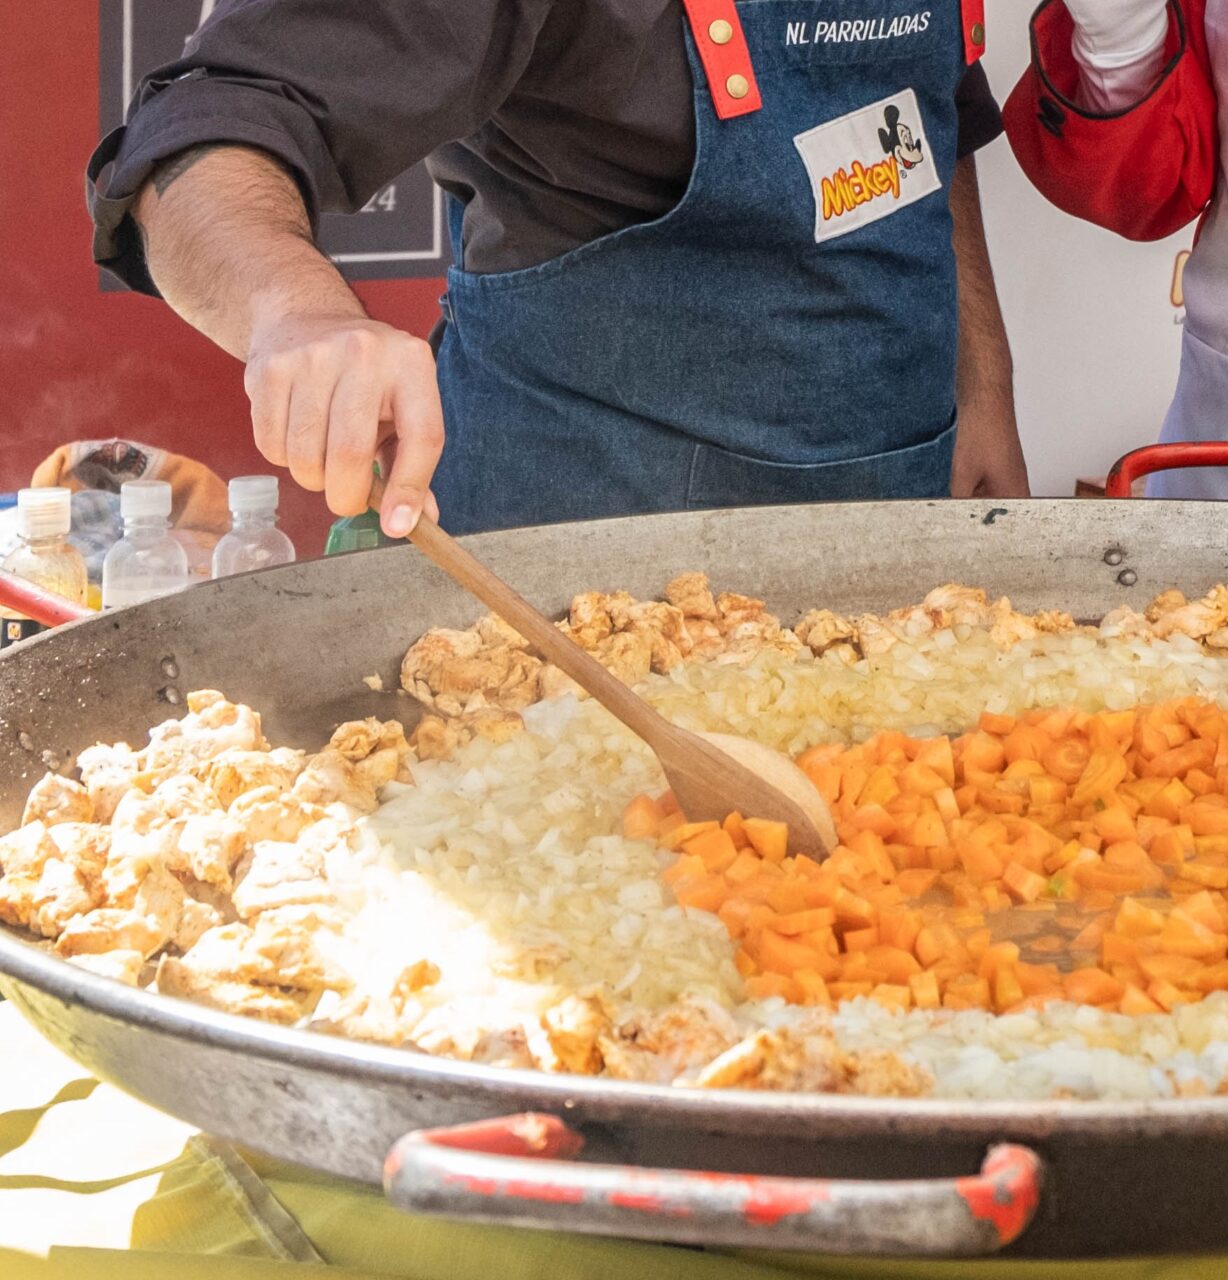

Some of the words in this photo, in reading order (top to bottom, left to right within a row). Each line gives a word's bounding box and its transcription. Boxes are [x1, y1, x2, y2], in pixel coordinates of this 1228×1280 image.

[786, 22, 810, 46] NL
[813, 11, 931, 44] PARRILLADAS
[821, 155, 900, 221] Mickey
